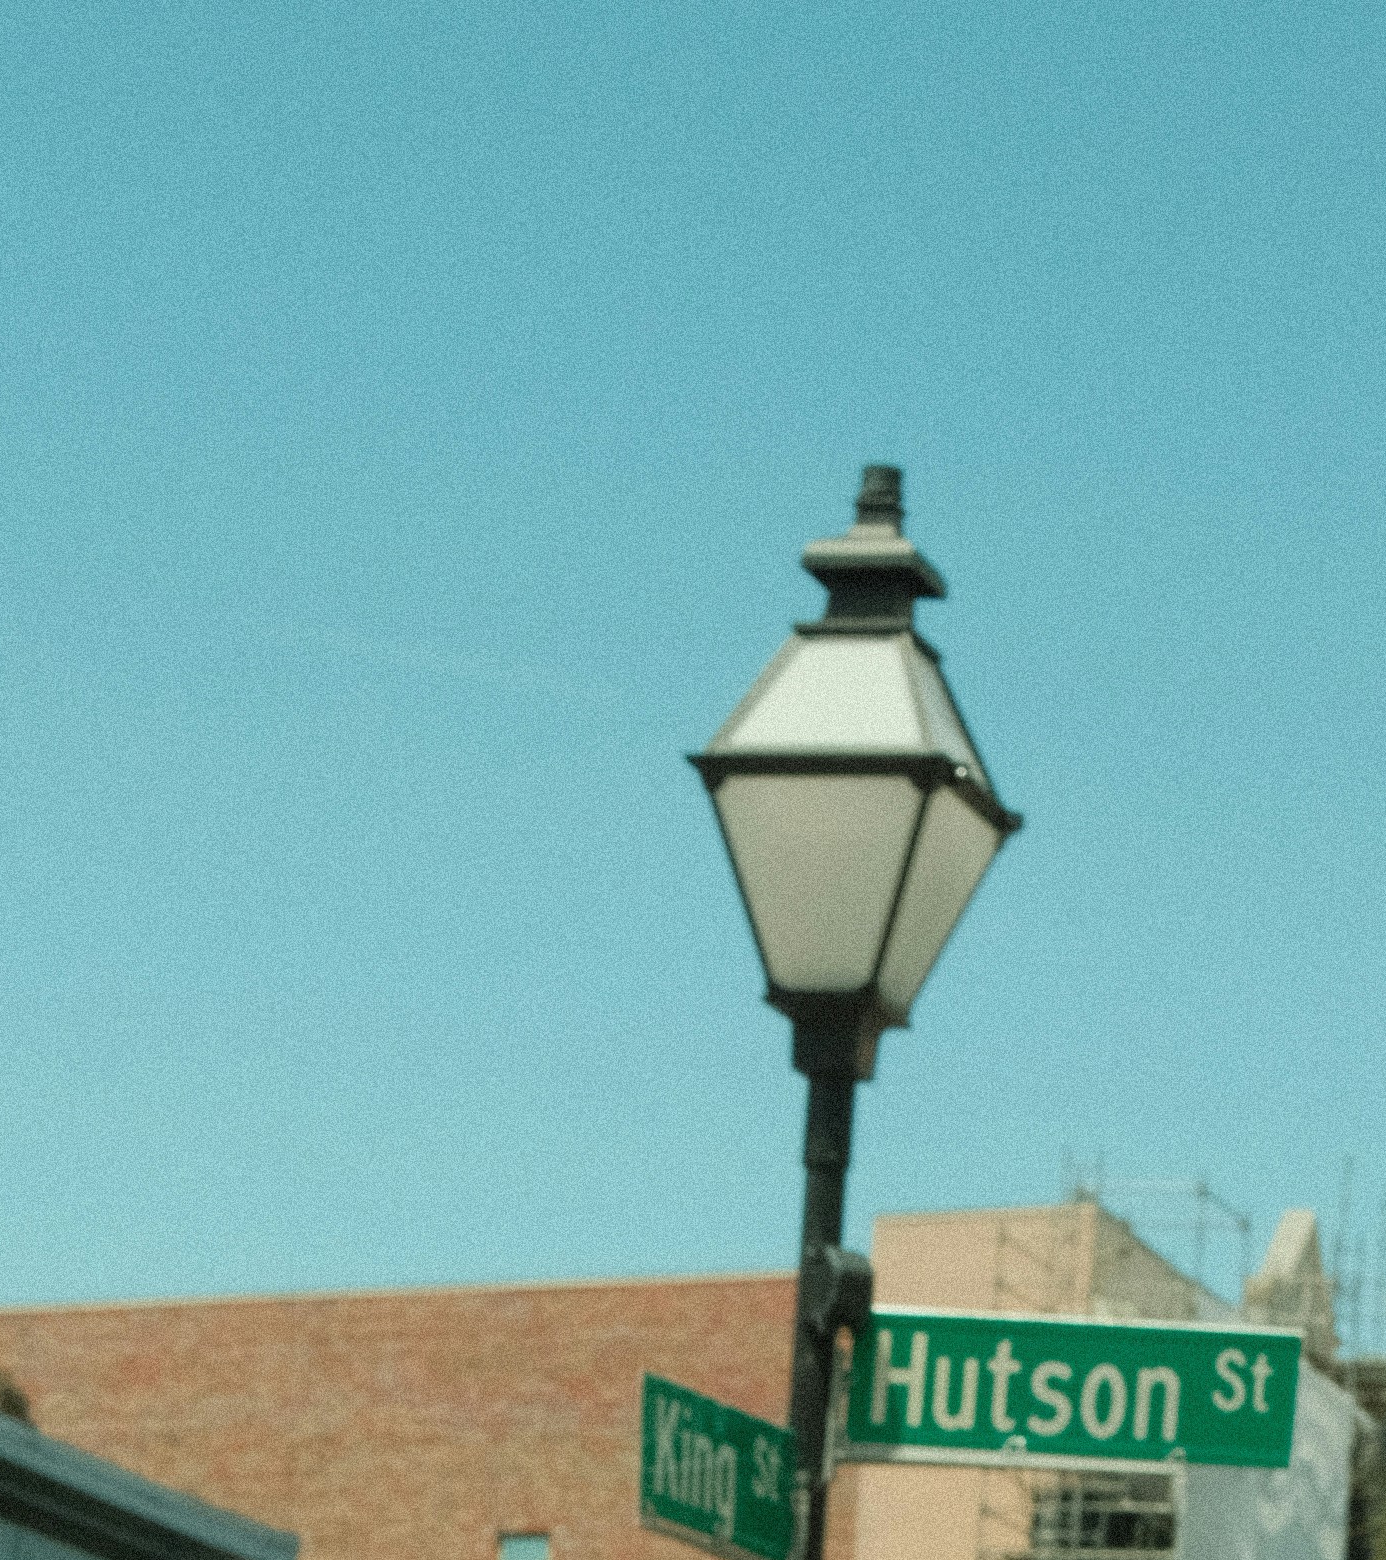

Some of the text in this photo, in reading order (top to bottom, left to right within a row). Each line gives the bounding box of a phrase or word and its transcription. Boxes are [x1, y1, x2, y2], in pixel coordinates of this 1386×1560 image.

[869, 1329, 1275, 1442] Hutson St
[653, 1393, 783, 1543] King St
